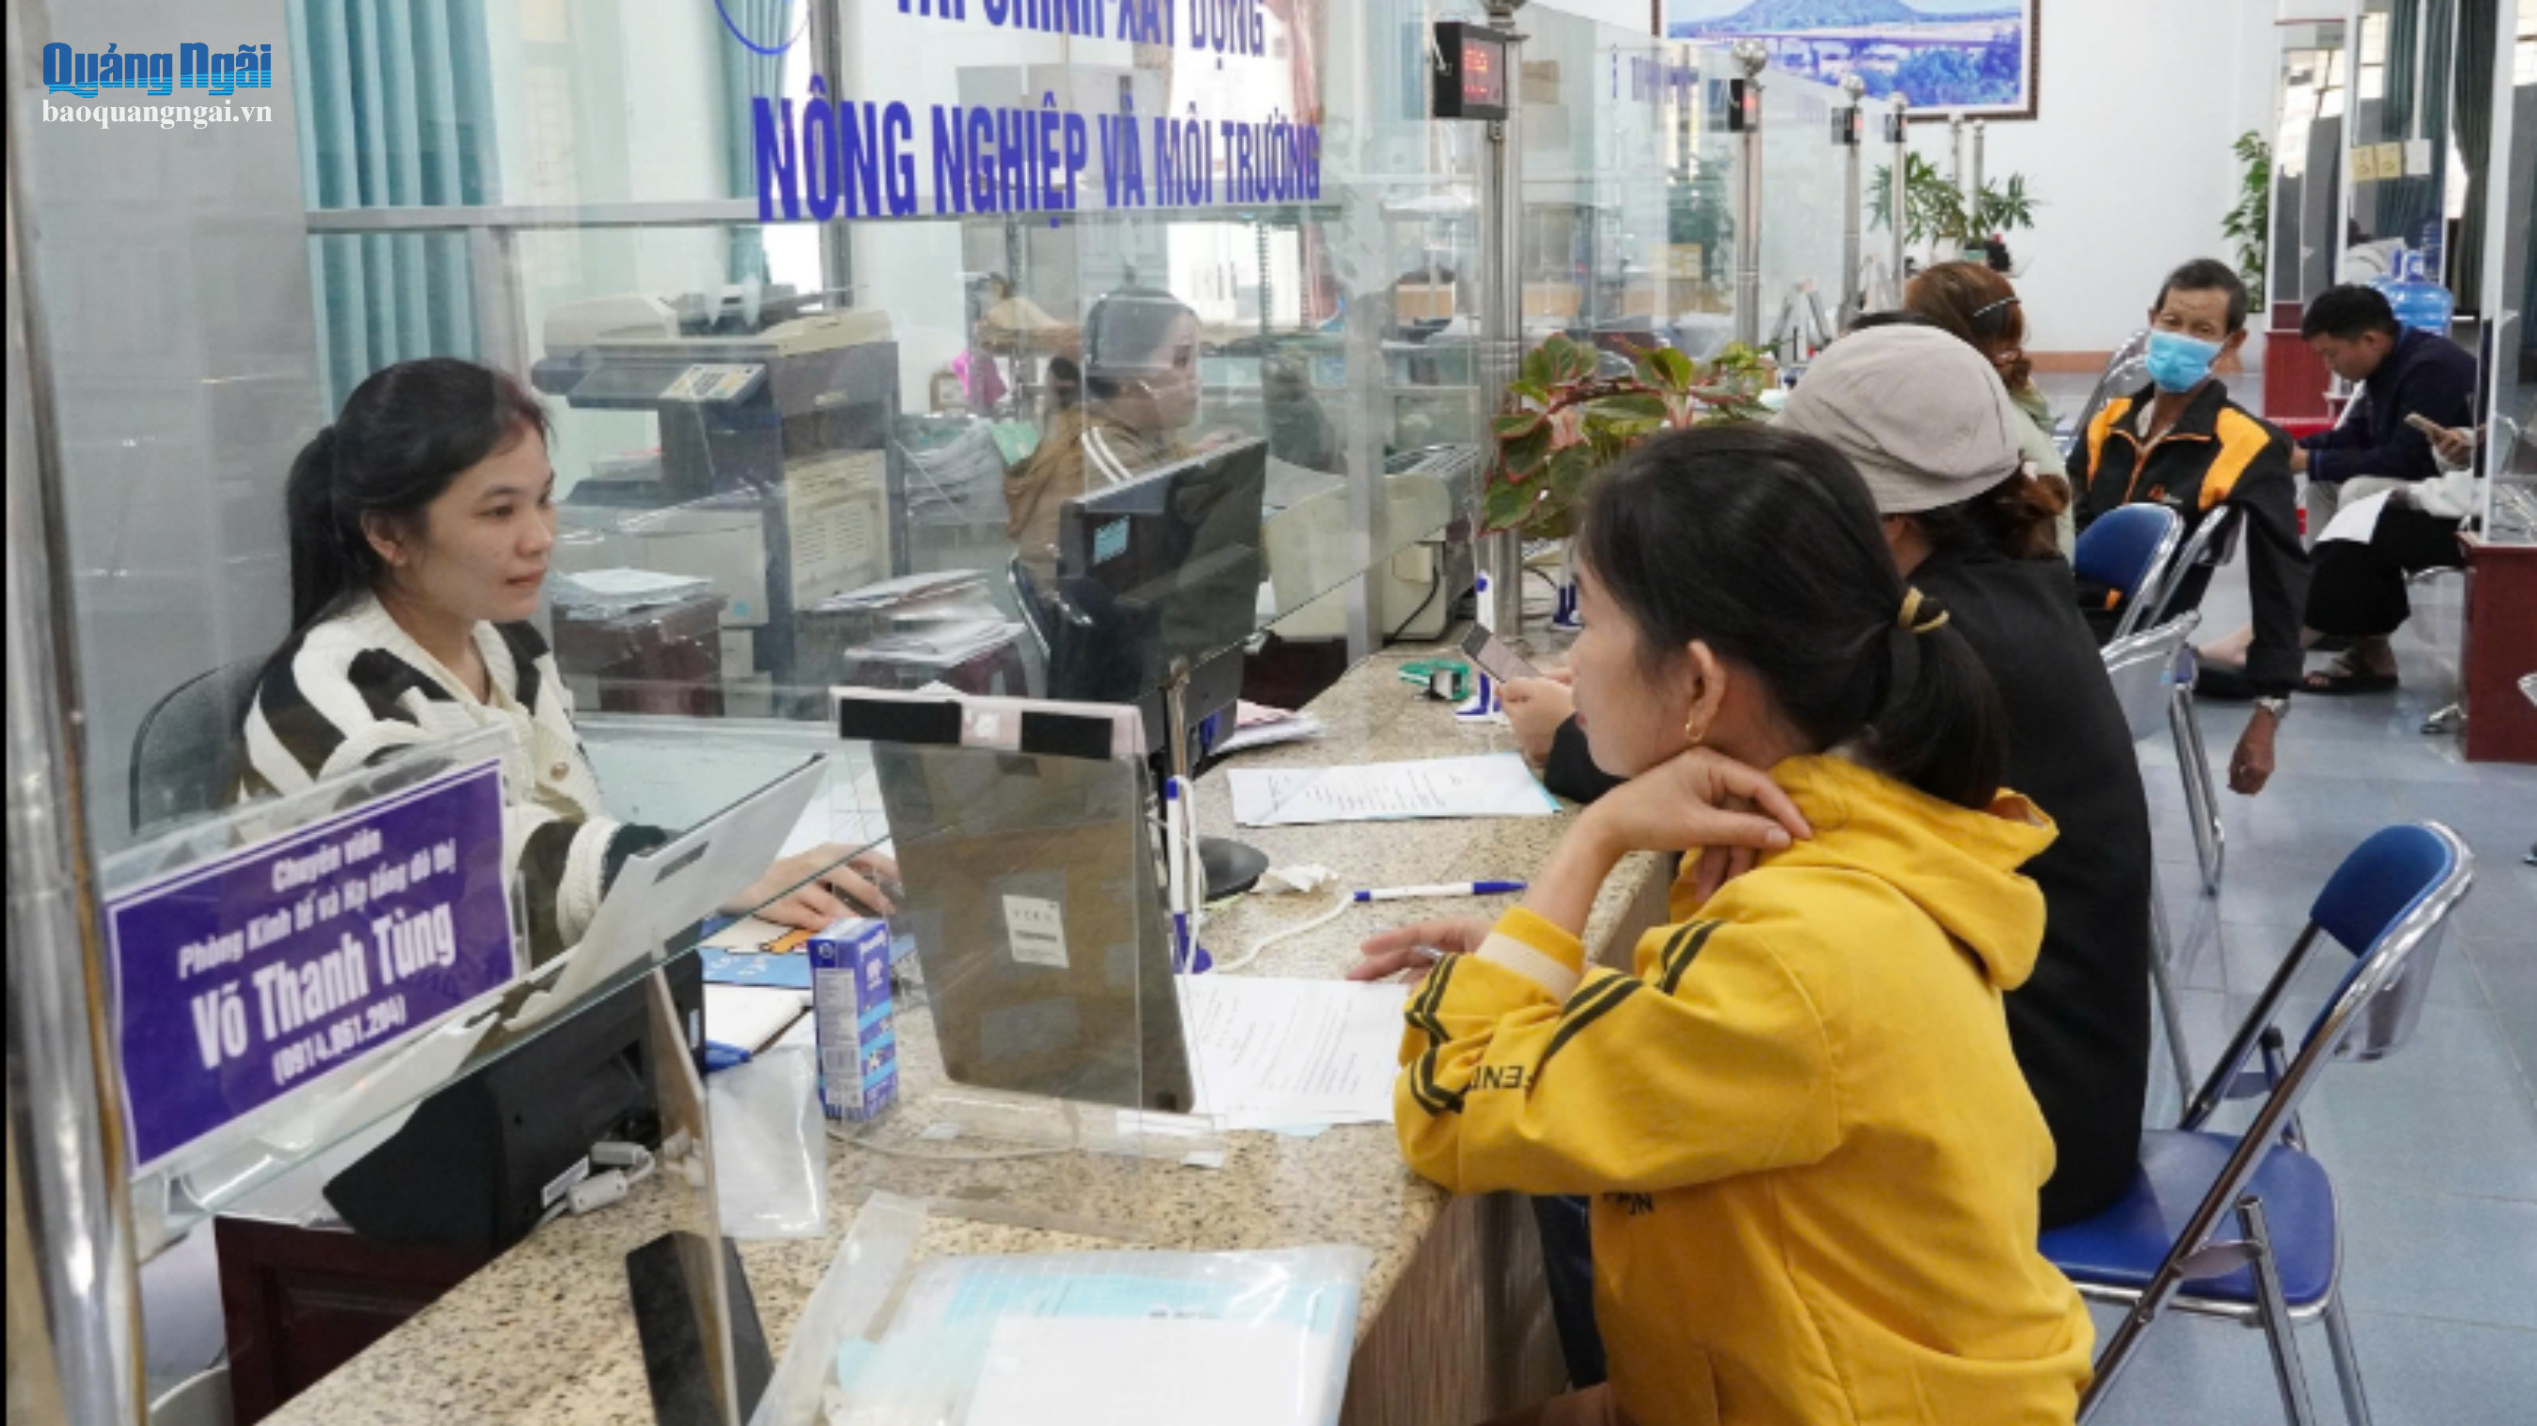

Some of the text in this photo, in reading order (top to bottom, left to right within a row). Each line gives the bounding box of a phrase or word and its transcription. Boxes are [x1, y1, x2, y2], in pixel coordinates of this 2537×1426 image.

[752, 73, 1322, 228] NÔNG NGHIỆP VÀ MÔI TRƯỜNG
[178, 930, 245, 980] Phòng
[246, 906, 293, 952] Kinh
[294, 889, 315, 931] tế
[318, 886, 341, 921] và
[432, 837, 457, 874] thị
[271, 827, 383, 893] Chuyên viên
[191, 900, 457, 1071] Võ Thanh Tùng
